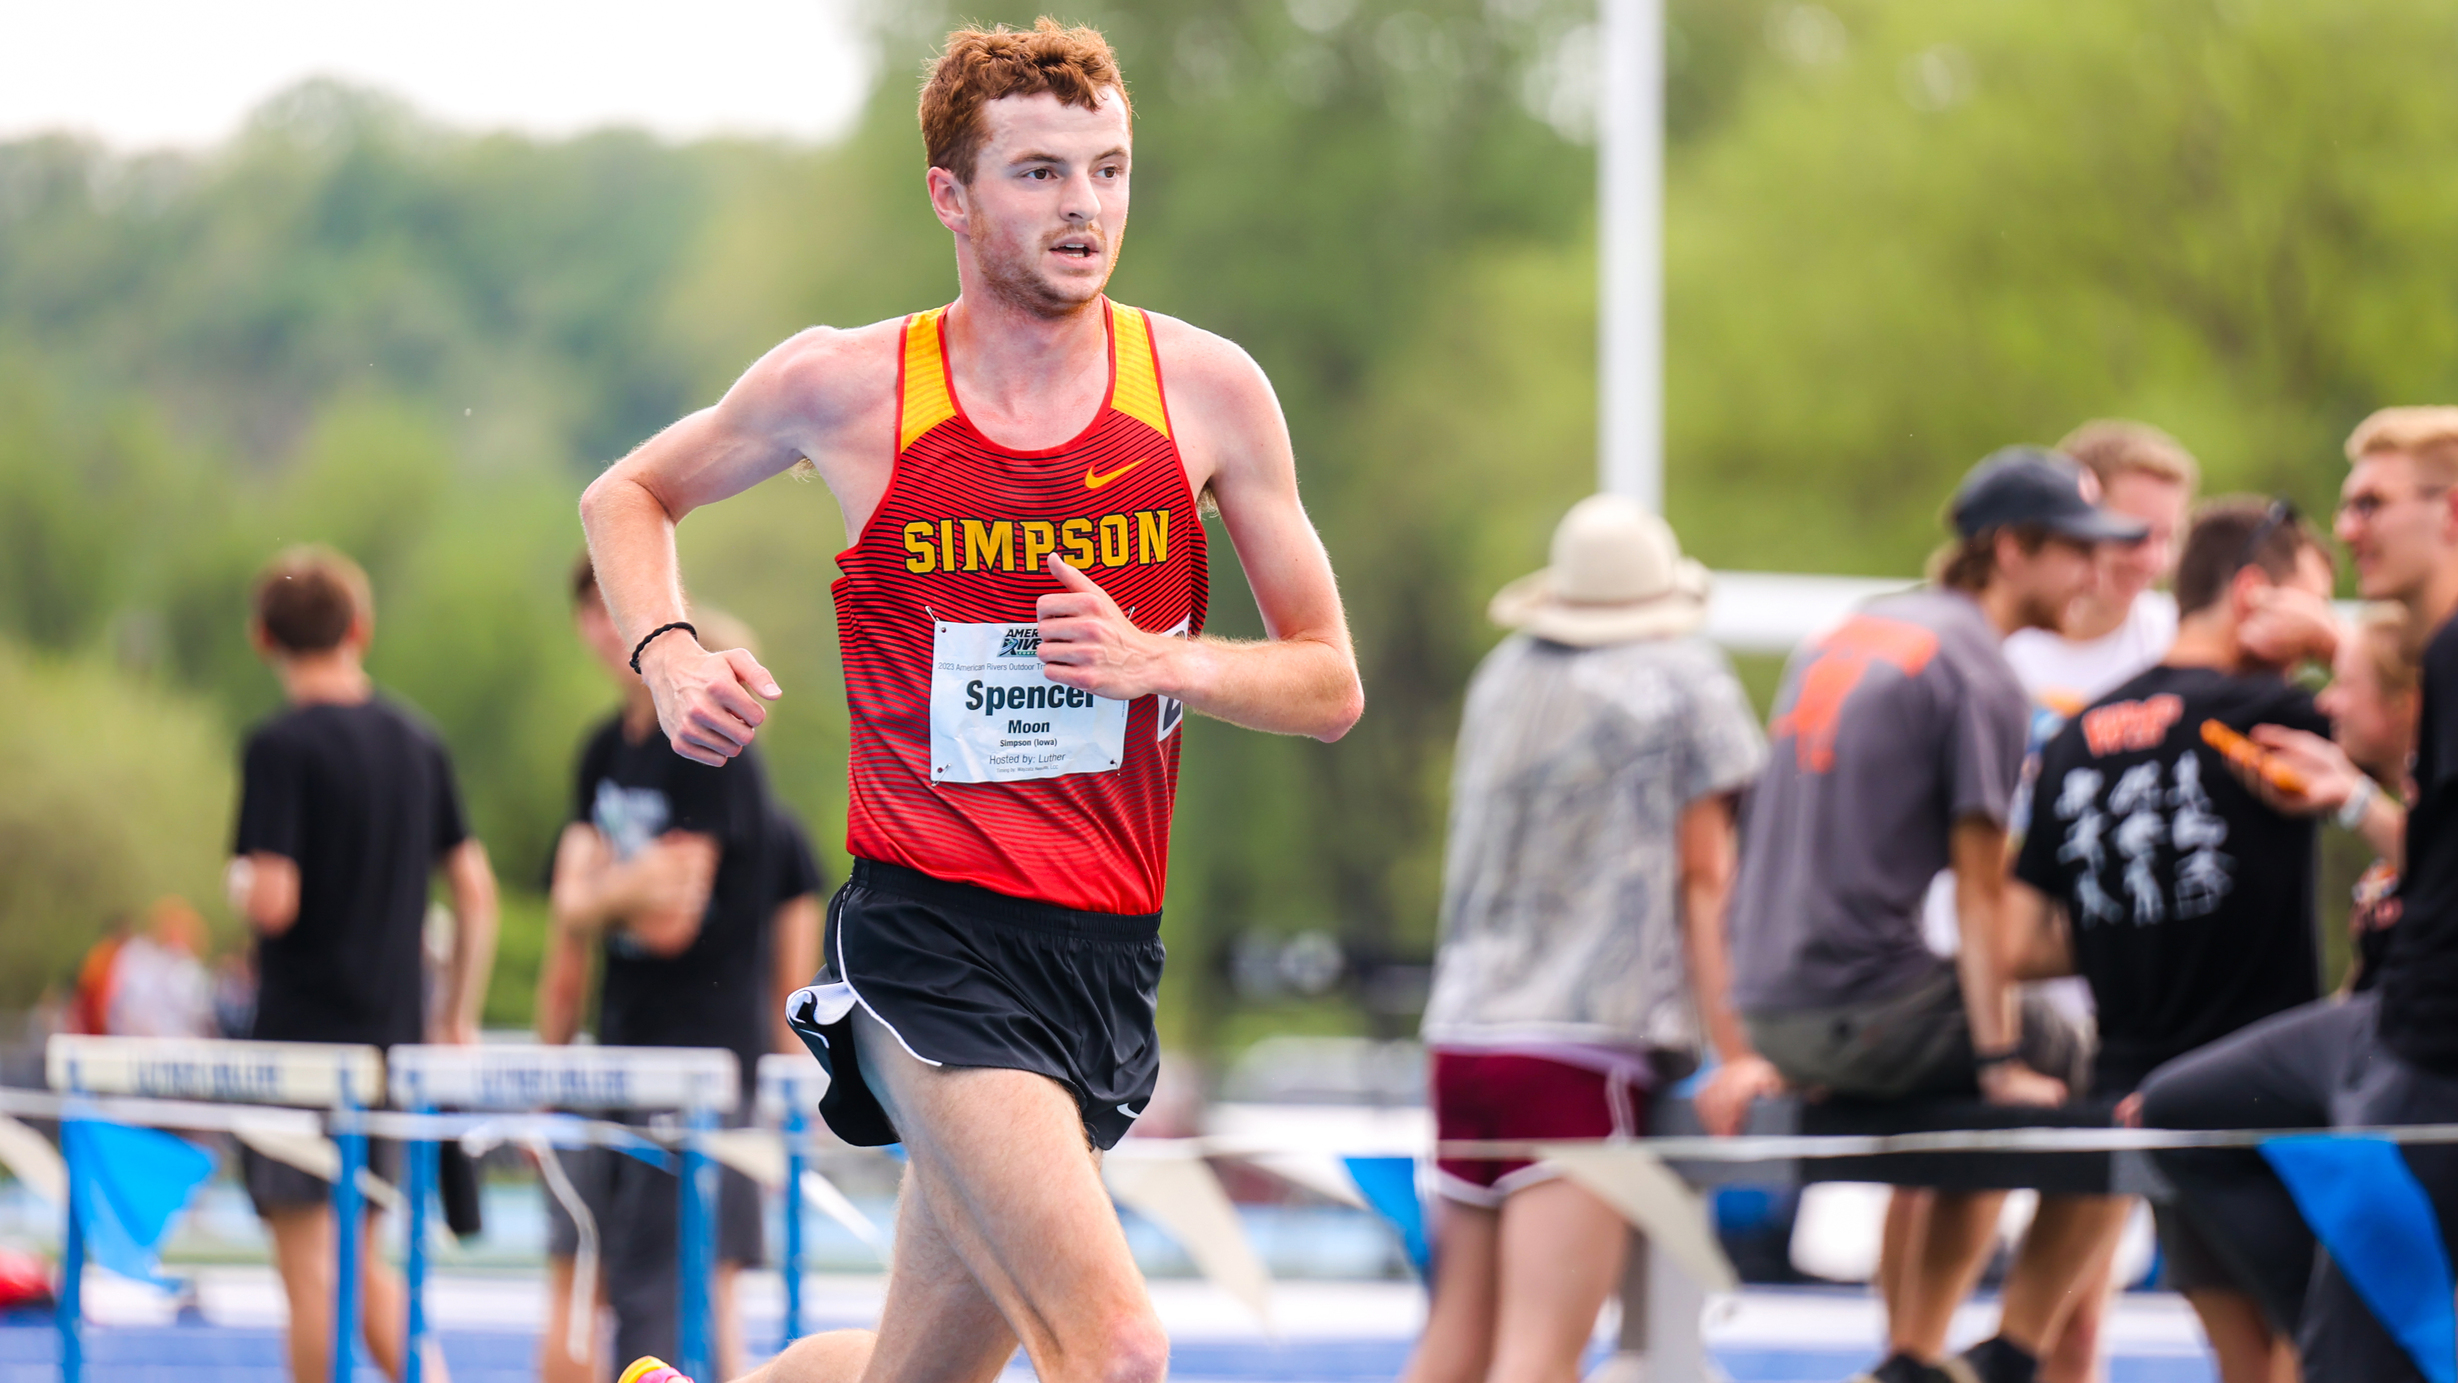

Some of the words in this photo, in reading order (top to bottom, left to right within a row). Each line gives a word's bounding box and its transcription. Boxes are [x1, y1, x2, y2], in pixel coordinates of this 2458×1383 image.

[902, 509, 1172, 574] SIMPSON
[1005, 628, 1039, 638] AMER
[999, 637, 1043, 657] RIVE
[938, 662, 955, 671] 2023
[955, 663, 985, 672] American
[986, 662, 1008, 671] Rivers
[1008, 662, 1035, 671] Outdoor
[1007, 719, 1050, 734] Moon
[1000, 739, 1032, 748] Simpson
[1033, 738, 1058, 748] (Iowa)
[989, 754, 1020, 765] Hosted
[1022, 754, 1036, 765] by:
[1038, 753, 1067, 763] Luther
